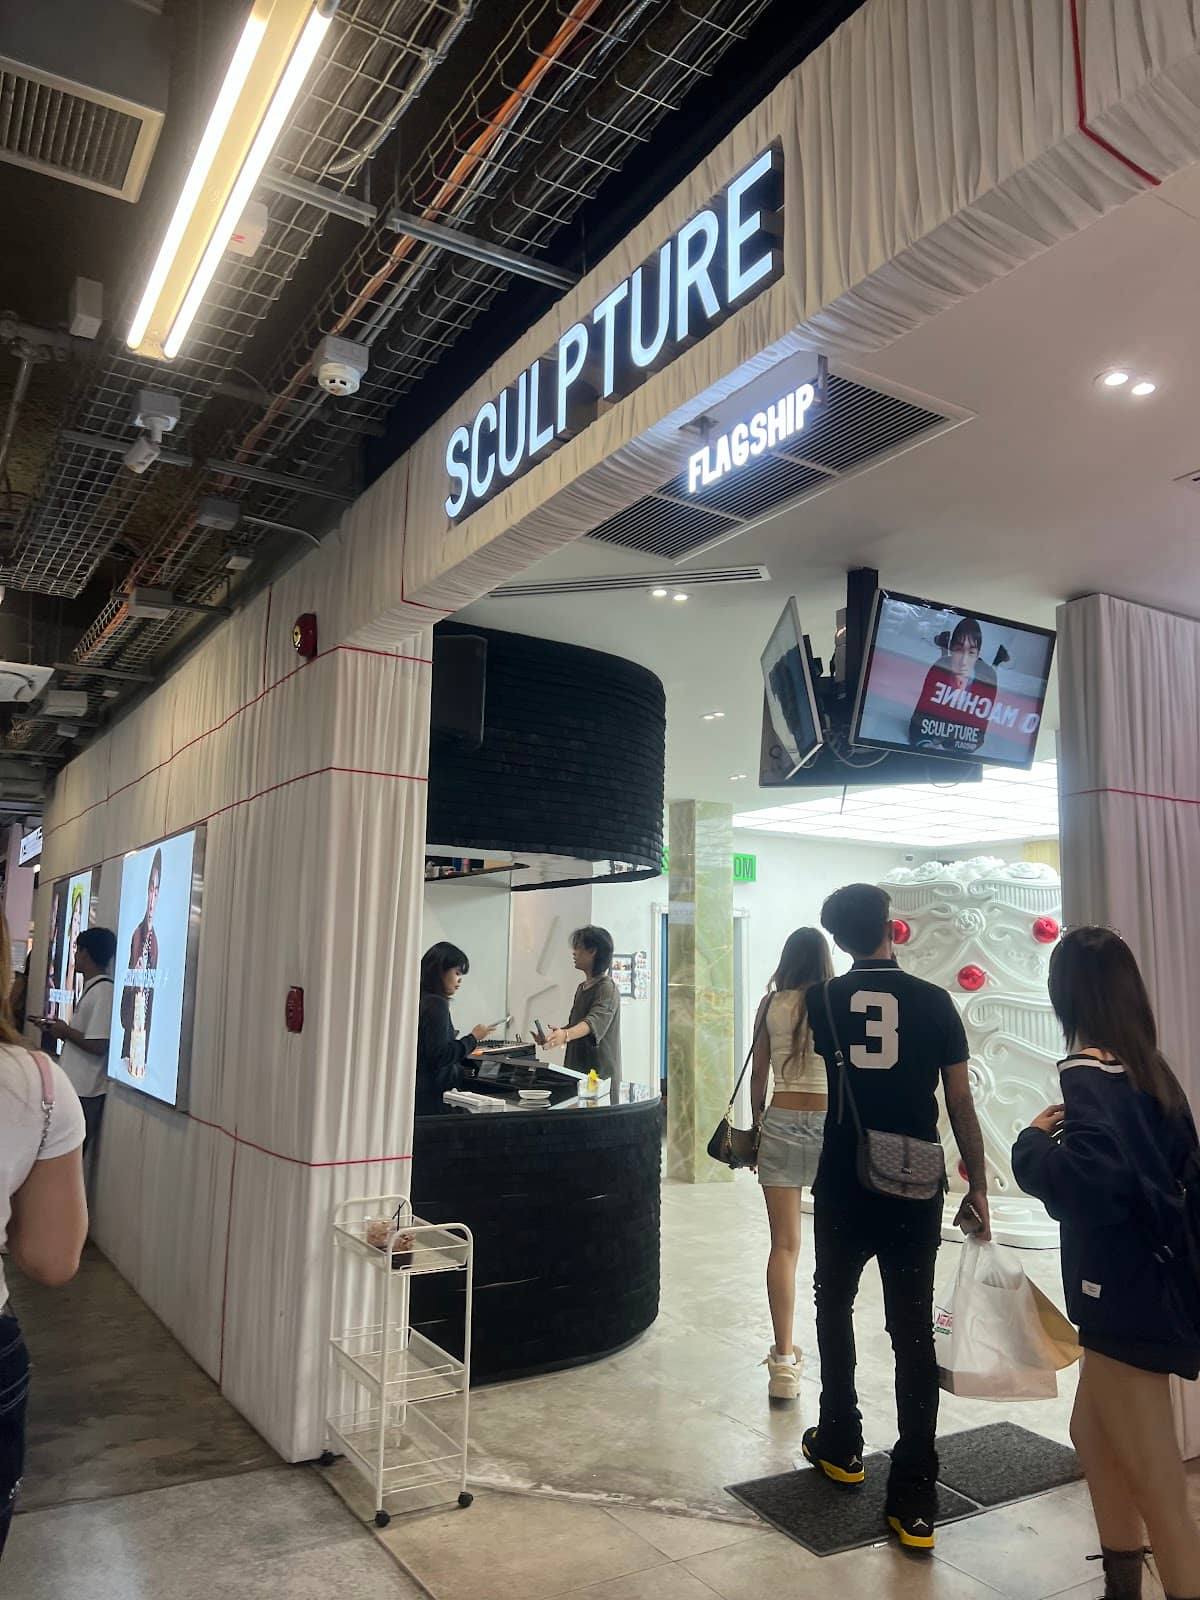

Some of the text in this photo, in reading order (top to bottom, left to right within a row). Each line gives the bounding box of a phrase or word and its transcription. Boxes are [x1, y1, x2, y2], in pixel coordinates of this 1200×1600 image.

[444, 149, 774, 518] SCULPTURE
[687, 382, 816, 494] FLAGSHIP
[920, 718, 980, 743] SCULPTURE
[849, 990, 899, 1070] 3
